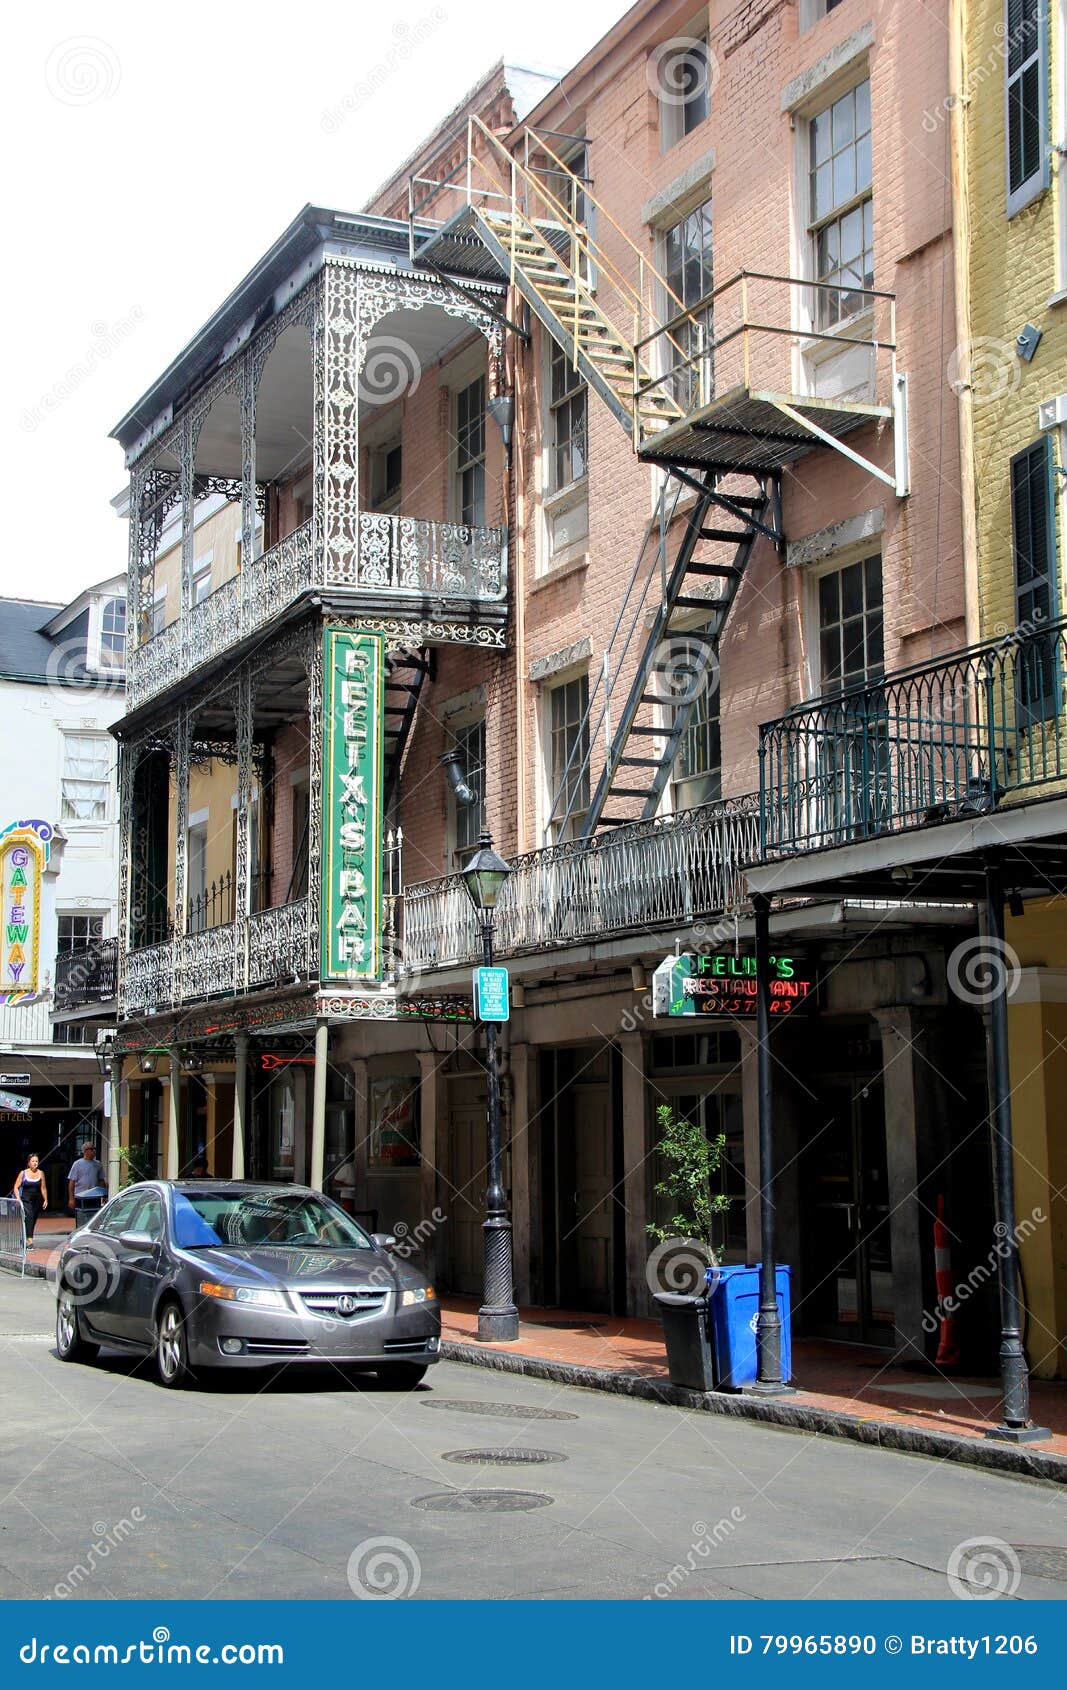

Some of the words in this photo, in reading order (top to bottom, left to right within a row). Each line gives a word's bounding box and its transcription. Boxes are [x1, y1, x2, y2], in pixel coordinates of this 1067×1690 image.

[6, 848, 29, 983] GATEWAY
[336, 870, 368, 963] BAR
[701, 956, 796, 979] FELI'S
[683, 977, 811, 997] RESTAUANT
[701, 999, 792, 1013] OYSTRS
